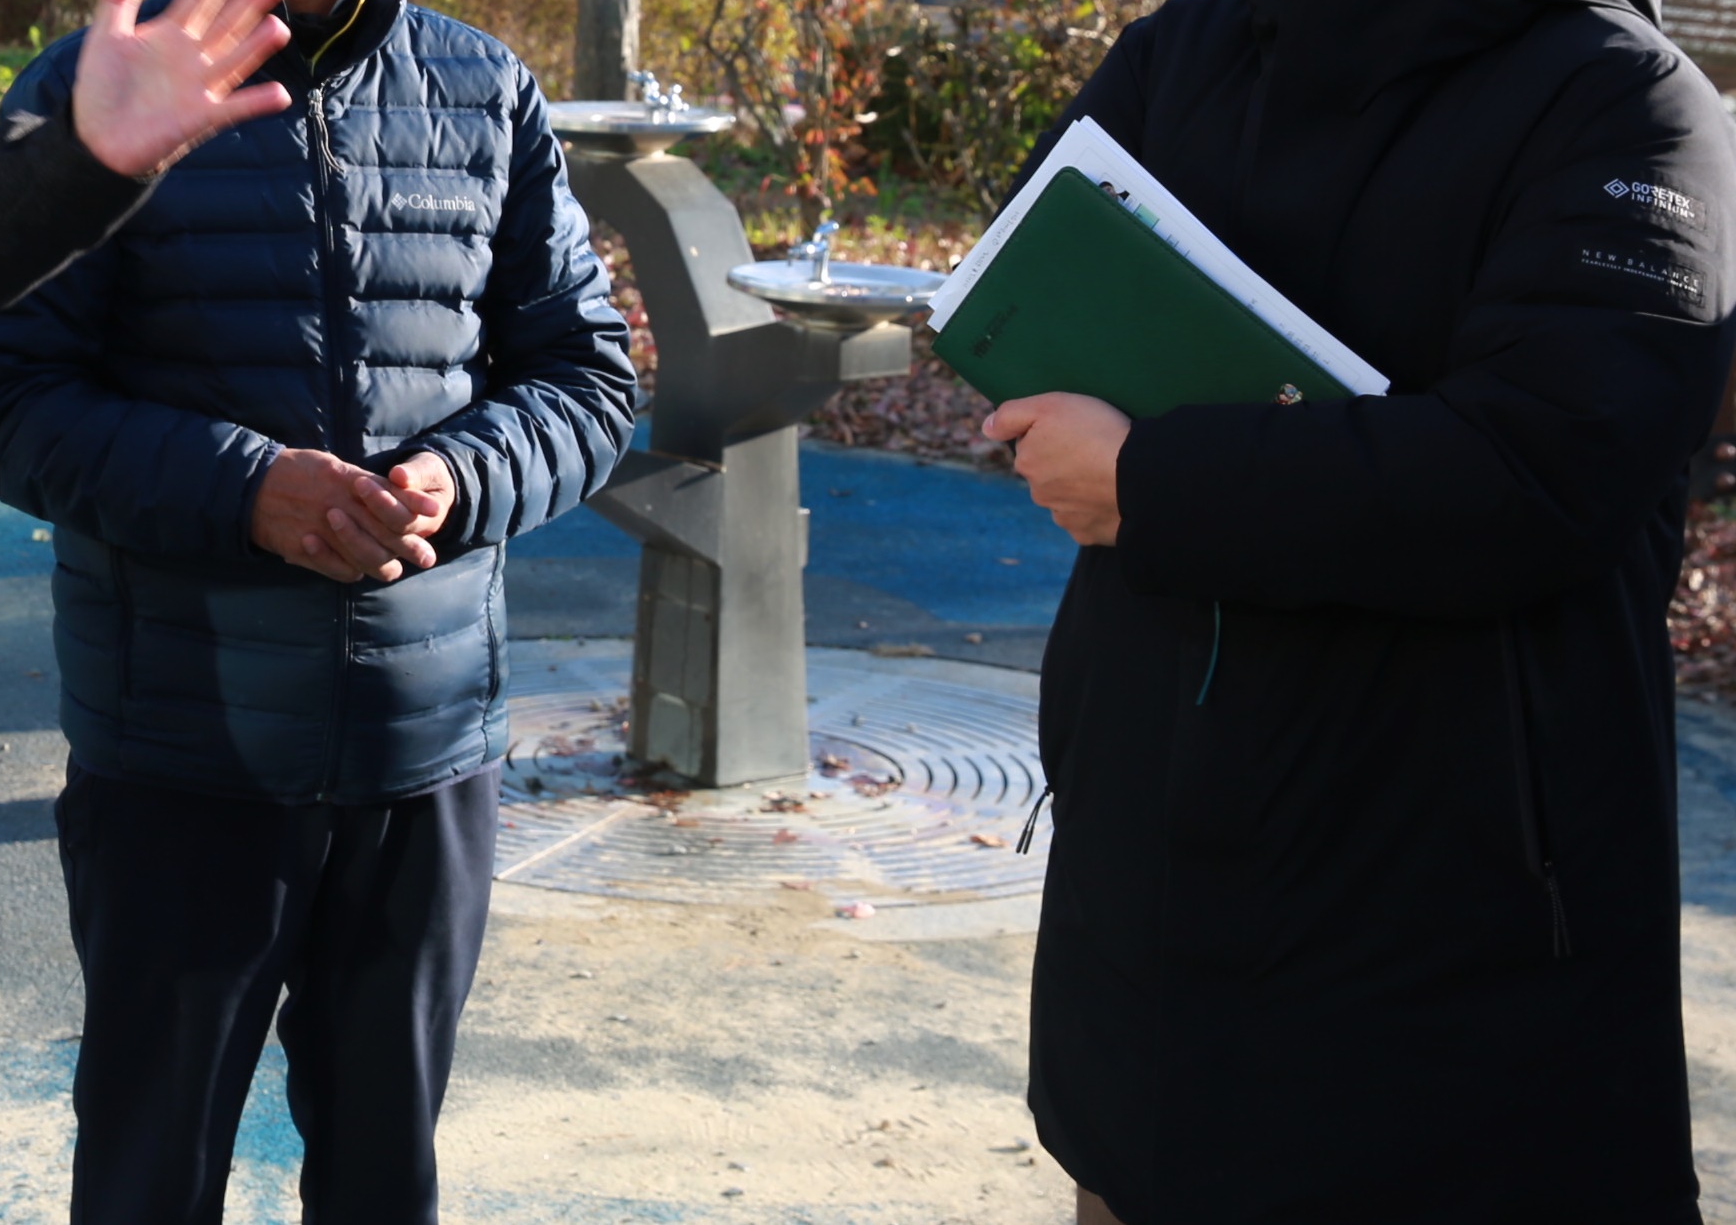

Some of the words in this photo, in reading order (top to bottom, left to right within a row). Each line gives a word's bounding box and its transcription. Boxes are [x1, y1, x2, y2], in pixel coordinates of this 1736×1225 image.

[408, 194, 475, 212] Columbia
[1632, 182, 1691, 209] GORE-TEX
[1582, 249, 1617, 262] NEW
[1627, 258, 1699, 287] BALANCE
